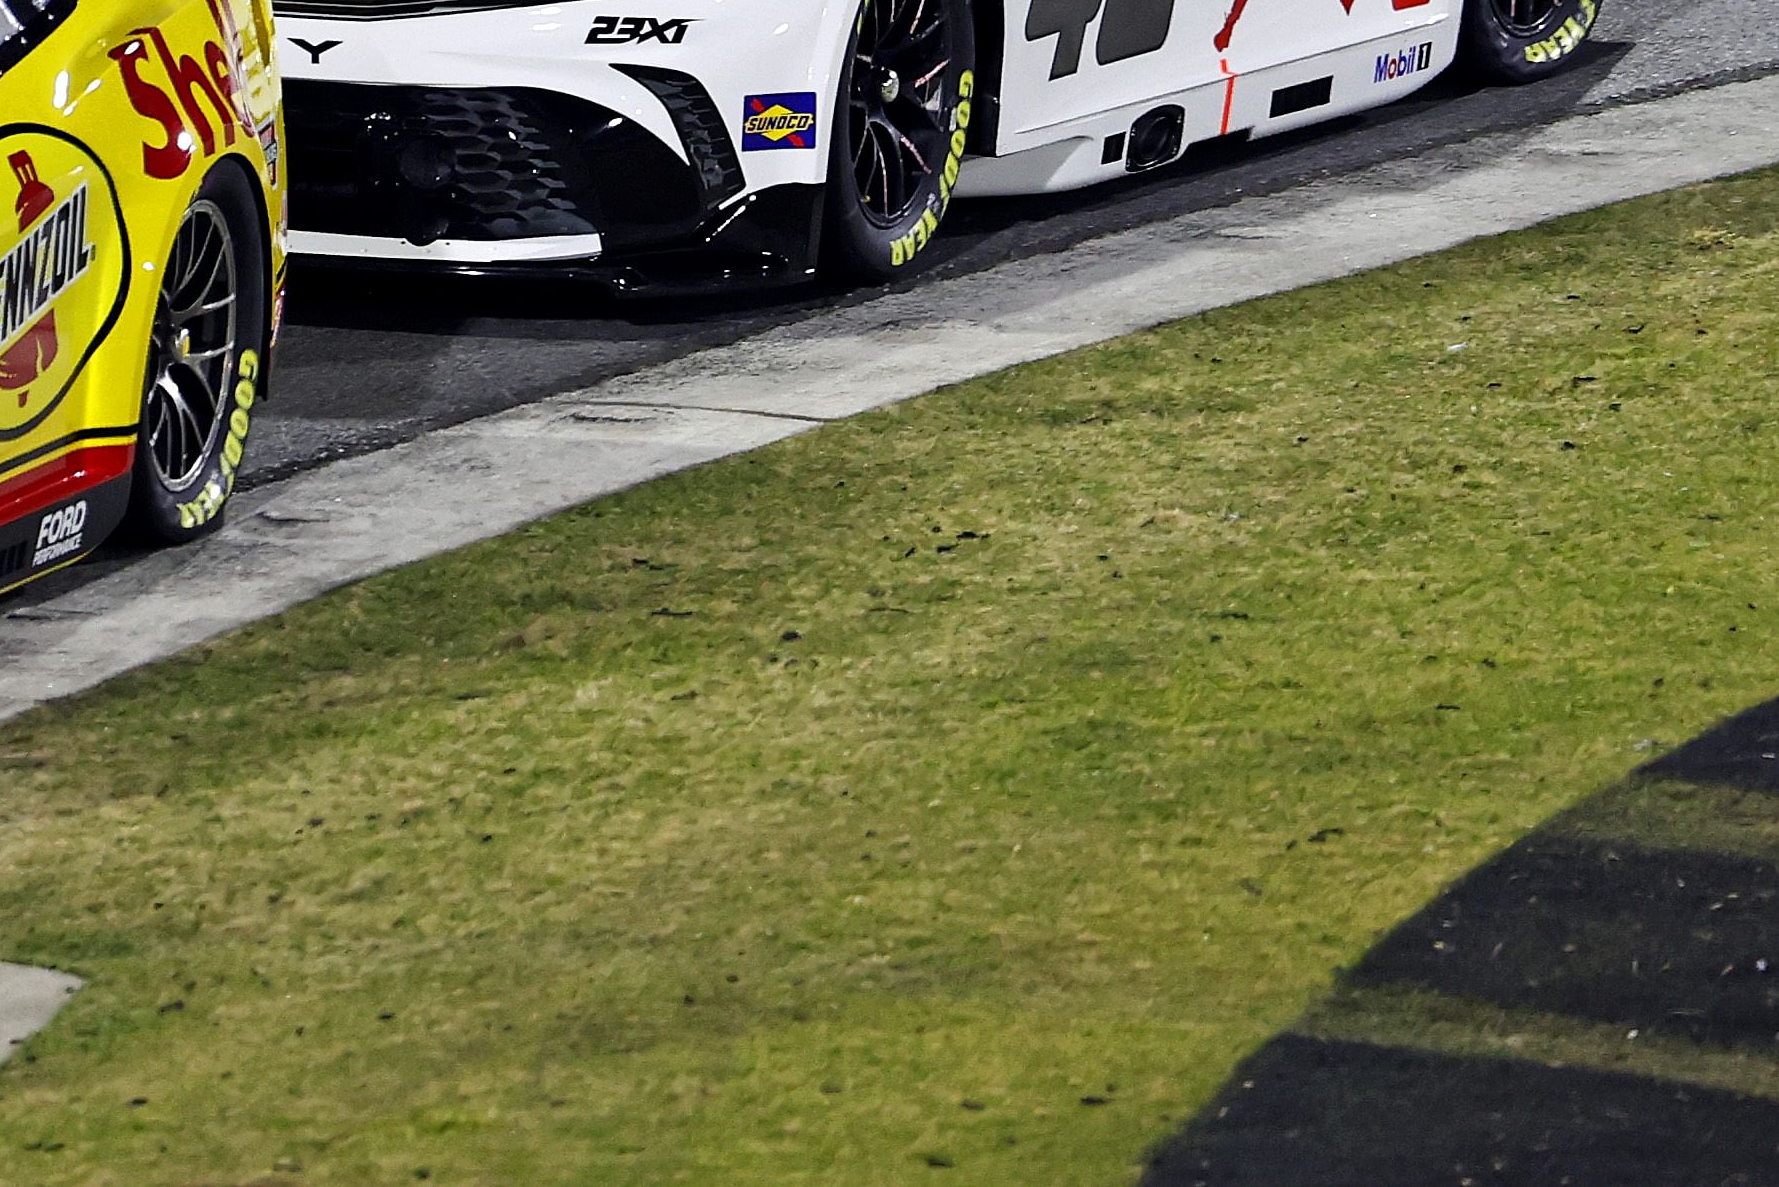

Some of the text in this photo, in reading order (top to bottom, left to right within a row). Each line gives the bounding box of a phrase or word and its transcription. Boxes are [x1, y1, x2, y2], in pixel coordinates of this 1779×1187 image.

[1373, 45, 1416, 84] Mobil
[747, 113, 811, 135] SUNOCO
[889, 68, 974, 266] GOODYEAR
[177, 348, 259, 529] GOODYEAR
[36, 499, 87, 550] FORD
